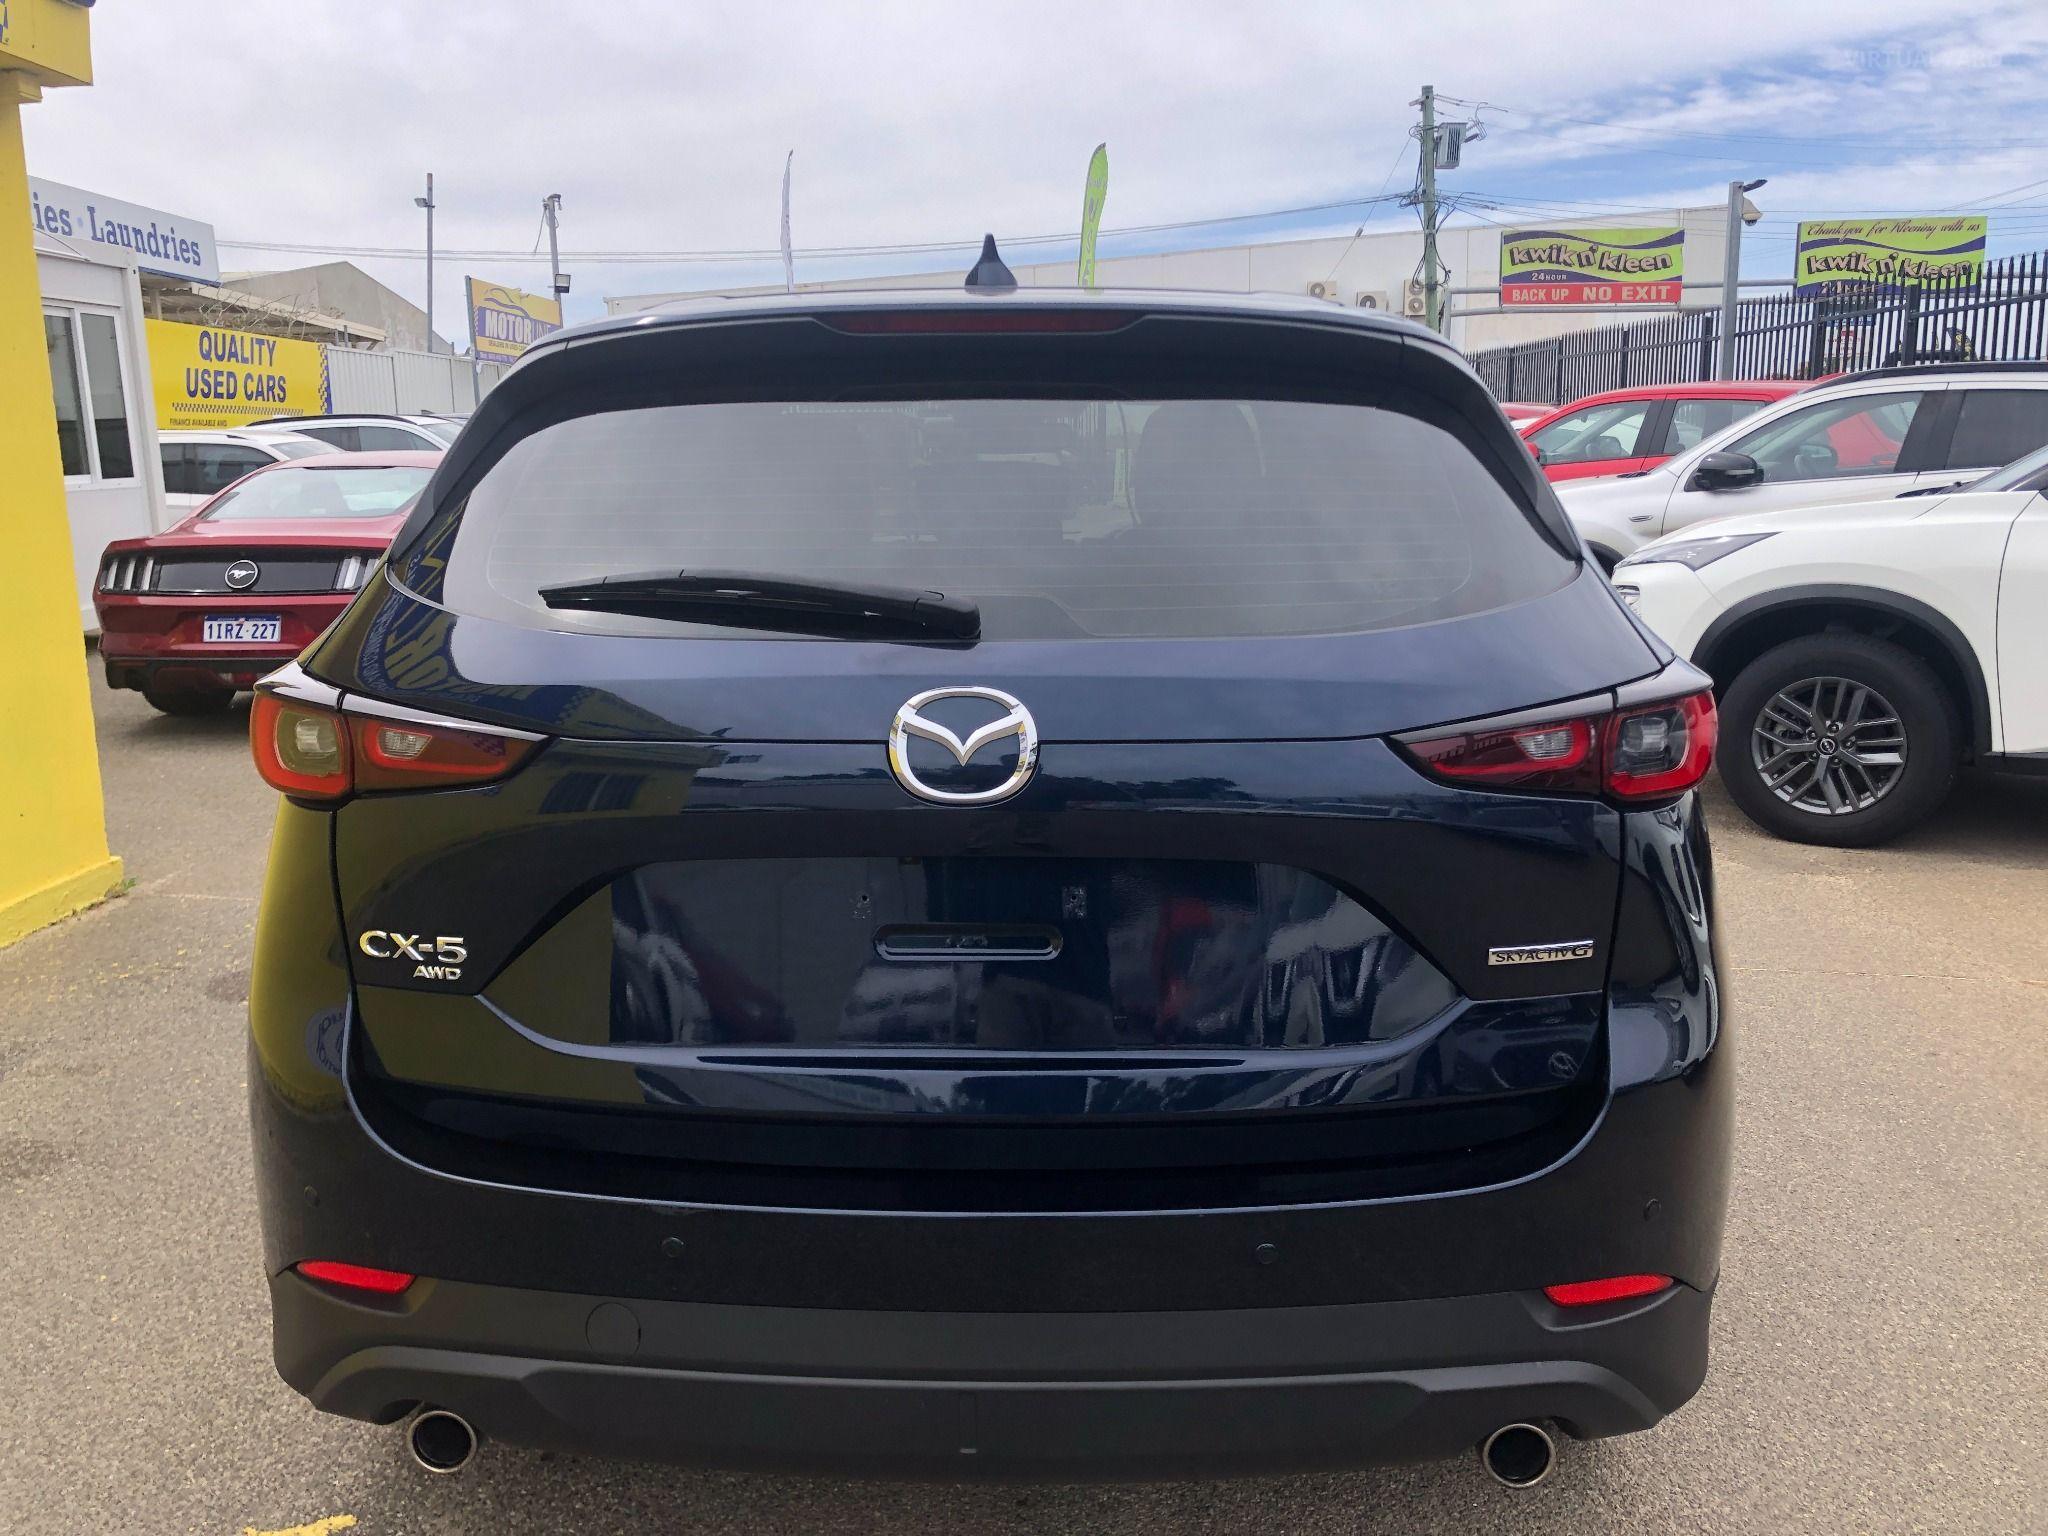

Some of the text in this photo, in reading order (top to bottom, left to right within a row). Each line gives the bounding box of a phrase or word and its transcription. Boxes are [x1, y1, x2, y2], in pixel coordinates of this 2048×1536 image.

[33, 191, 201, 266] ies Laundries
[1510, 244, 1575, 268] kwik
[1598, 250, 1673, 273] kleen
[1807, 251, 1875, 274] kwik
[1512, 286, 1672, 302] BACK UP NO EXIT
[199, 330, 277, 367] QUALITY
[186, 367, 287, 403] USED CARS
[169, 418, 191, 426] FINANCE
[192, 419, 216, 427] AVAILABLE
[359, 930, 468, 963] CX-5
[413, 965, 461, 980] AWD
